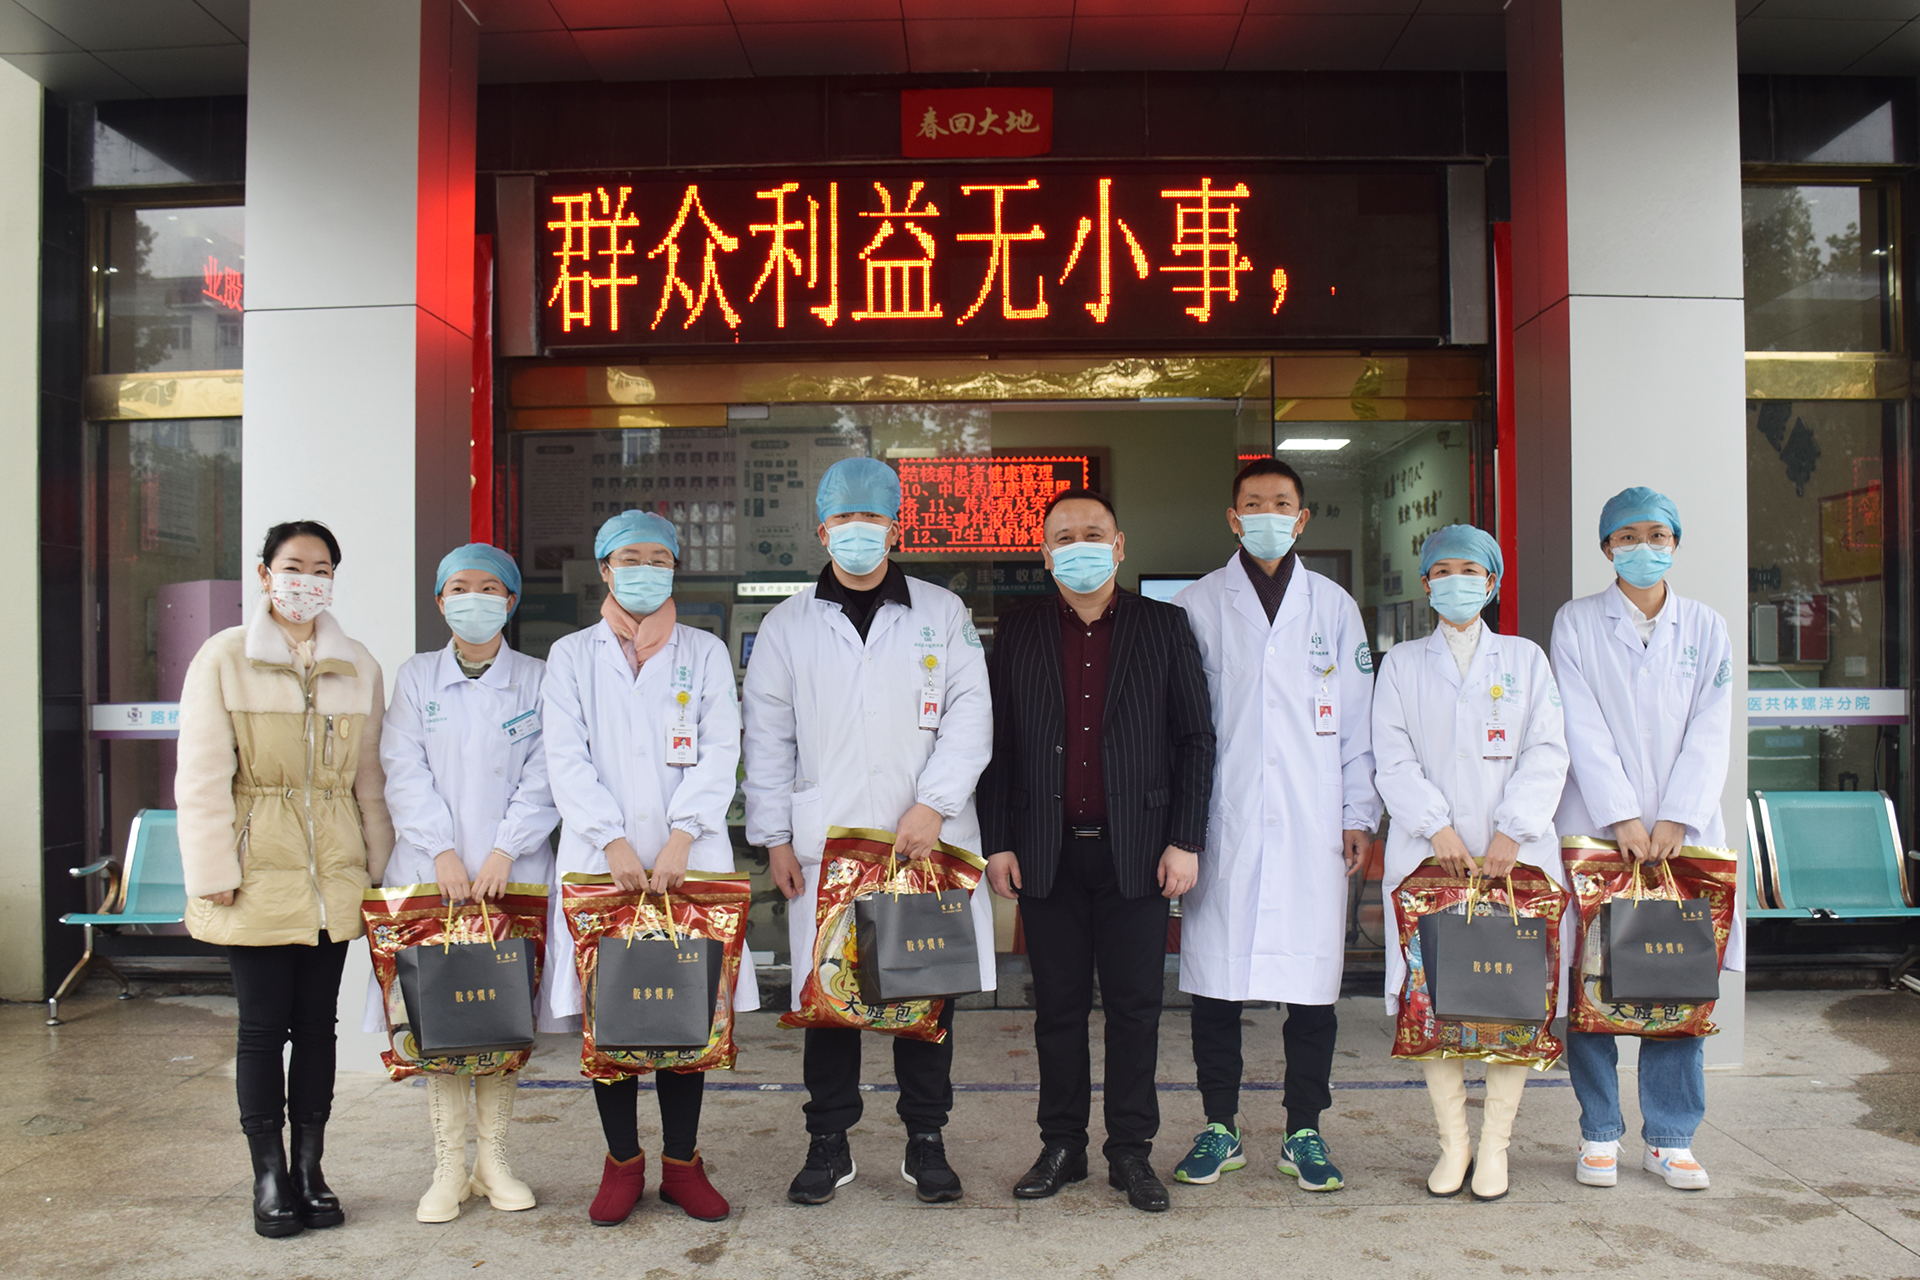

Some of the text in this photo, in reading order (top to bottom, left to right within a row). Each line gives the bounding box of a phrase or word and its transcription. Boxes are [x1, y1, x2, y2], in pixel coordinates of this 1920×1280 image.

[916, 105, 1040, 140] 春回大地
[547, 178, 1288, 332] 群众利益无小事，
[903, 465, 1054, 482] 结核病患者健康管理
[928, 497, 1053, 514] 11、传染病及突
[1747, 696, 1871, 711] 医共体螺洋分院
